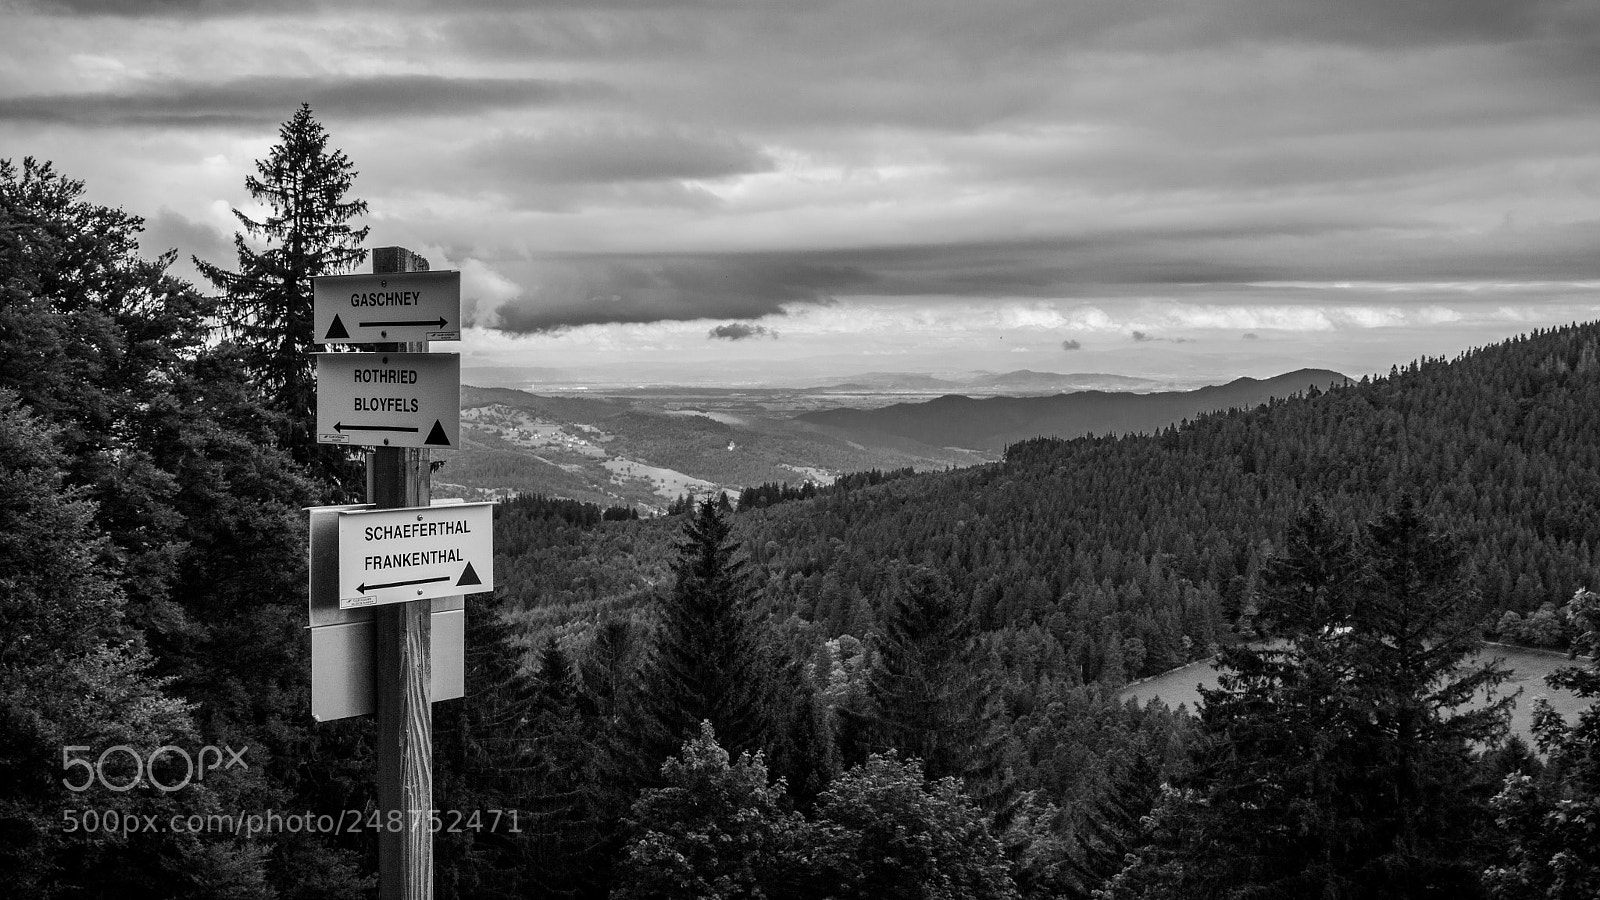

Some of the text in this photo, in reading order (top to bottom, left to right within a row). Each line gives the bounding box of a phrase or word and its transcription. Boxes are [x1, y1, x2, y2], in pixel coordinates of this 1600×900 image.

[351, 292, 420, 307] GASCHNEY
[354, 369, 418, 384] ROTHRIED
[354, 398, 419, 412] BLOYFELS
[364, 520, 471, 541] SCHAEFERTHAL
[364, 549, 464, 571] FRANKENTHAL
